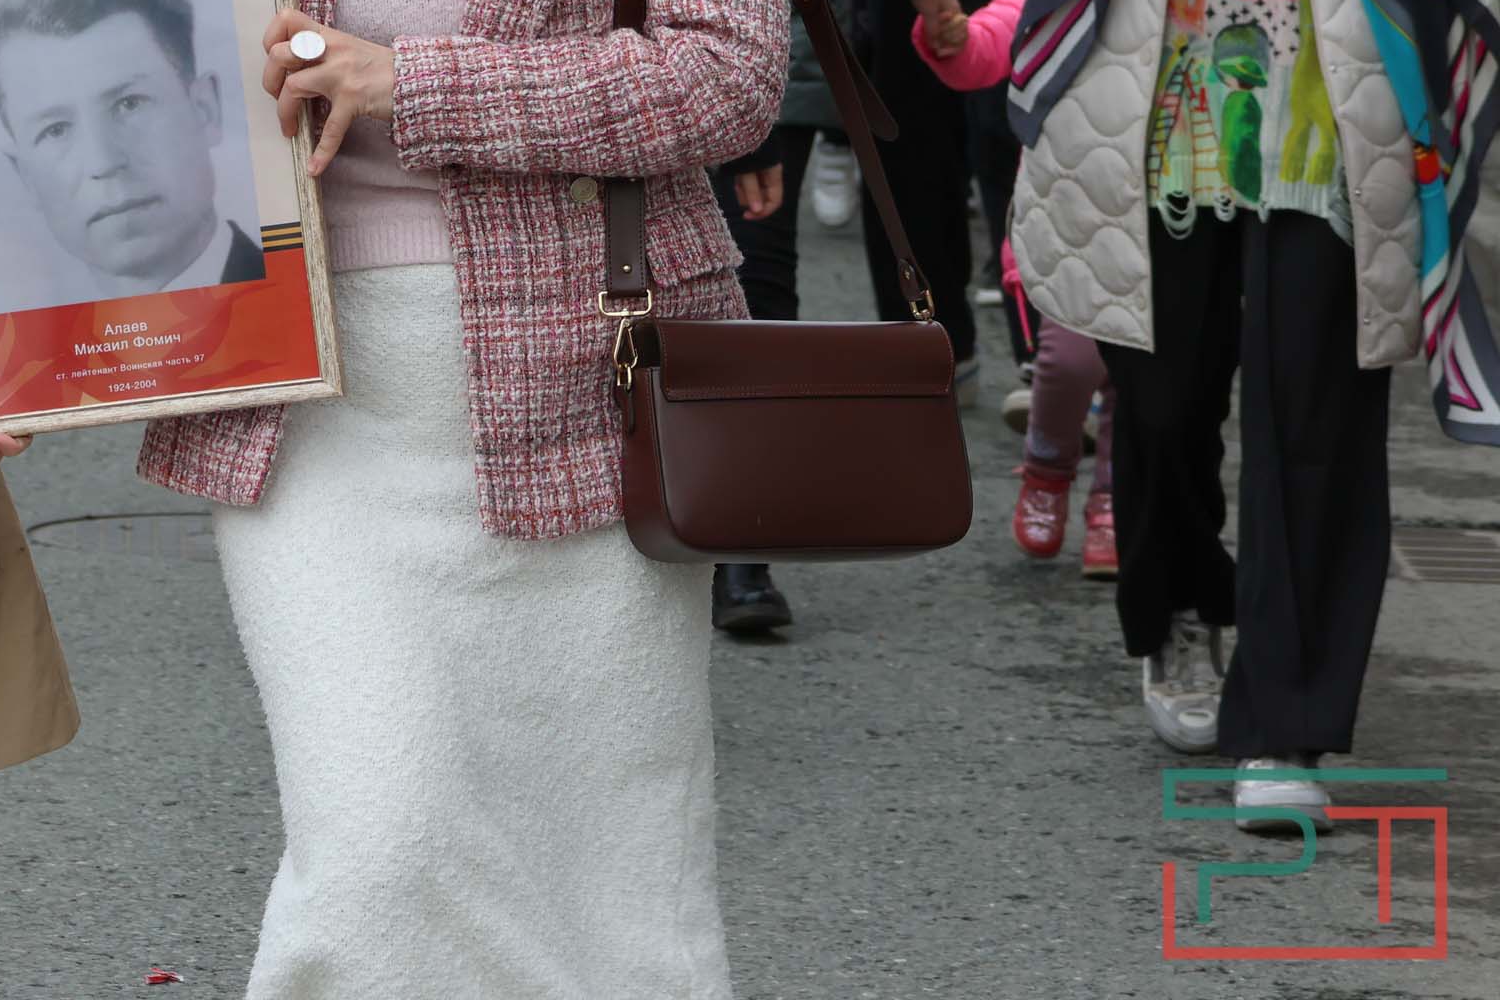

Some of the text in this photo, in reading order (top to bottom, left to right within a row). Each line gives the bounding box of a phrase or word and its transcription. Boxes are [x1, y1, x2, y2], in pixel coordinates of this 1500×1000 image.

[104, 322, 148, 336] Алаев
[74, 333, 181, 356] Михаил Фомич
[55, 353, 205, 381] ст. лейтенант Воинская часть 97
[108, 379, 157, 393] 1924-2004
